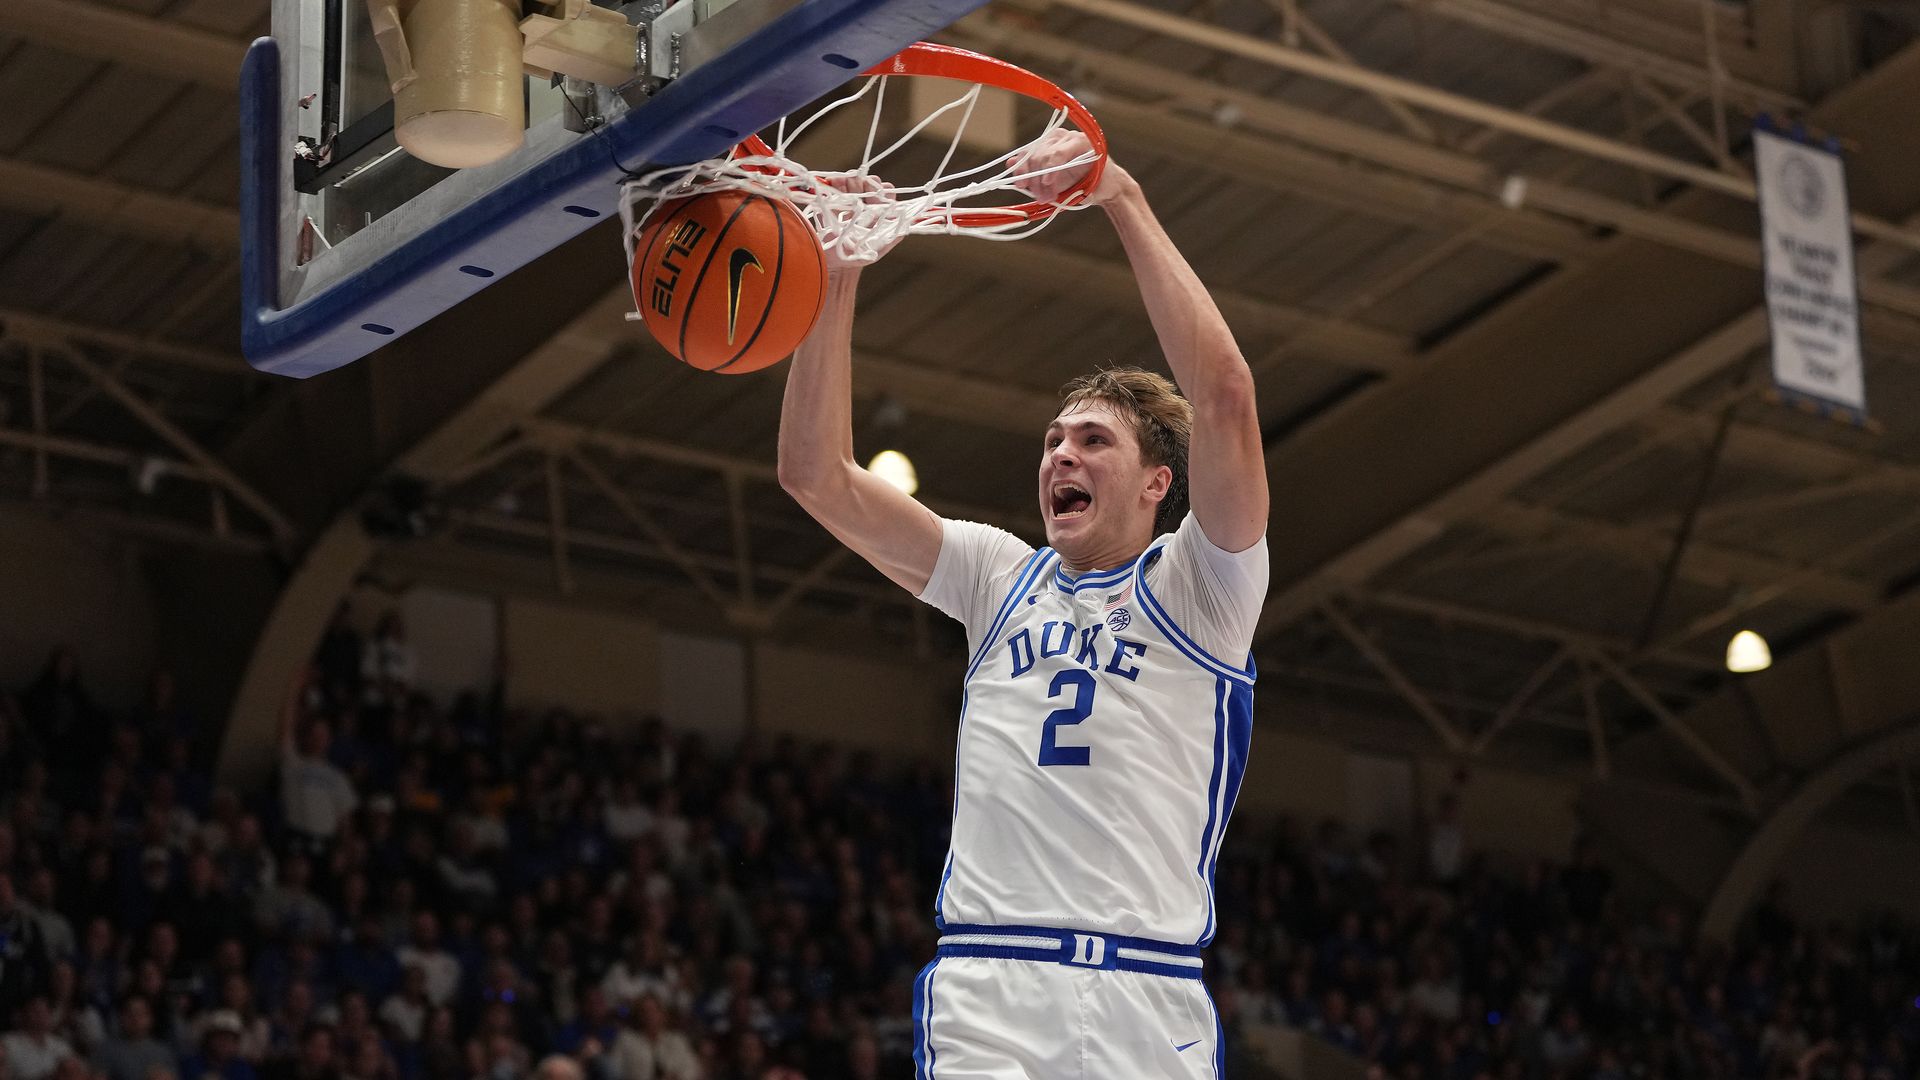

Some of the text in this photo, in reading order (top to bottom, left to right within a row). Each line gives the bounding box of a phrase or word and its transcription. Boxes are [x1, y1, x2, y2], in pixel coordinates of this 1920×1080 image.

[652, 219, 706, 317] ELITE
[1007, 621, 1148, 682] DUKE
[1038, 668, 1096, 766] 2
[1071, 933, 1106, 966] D
